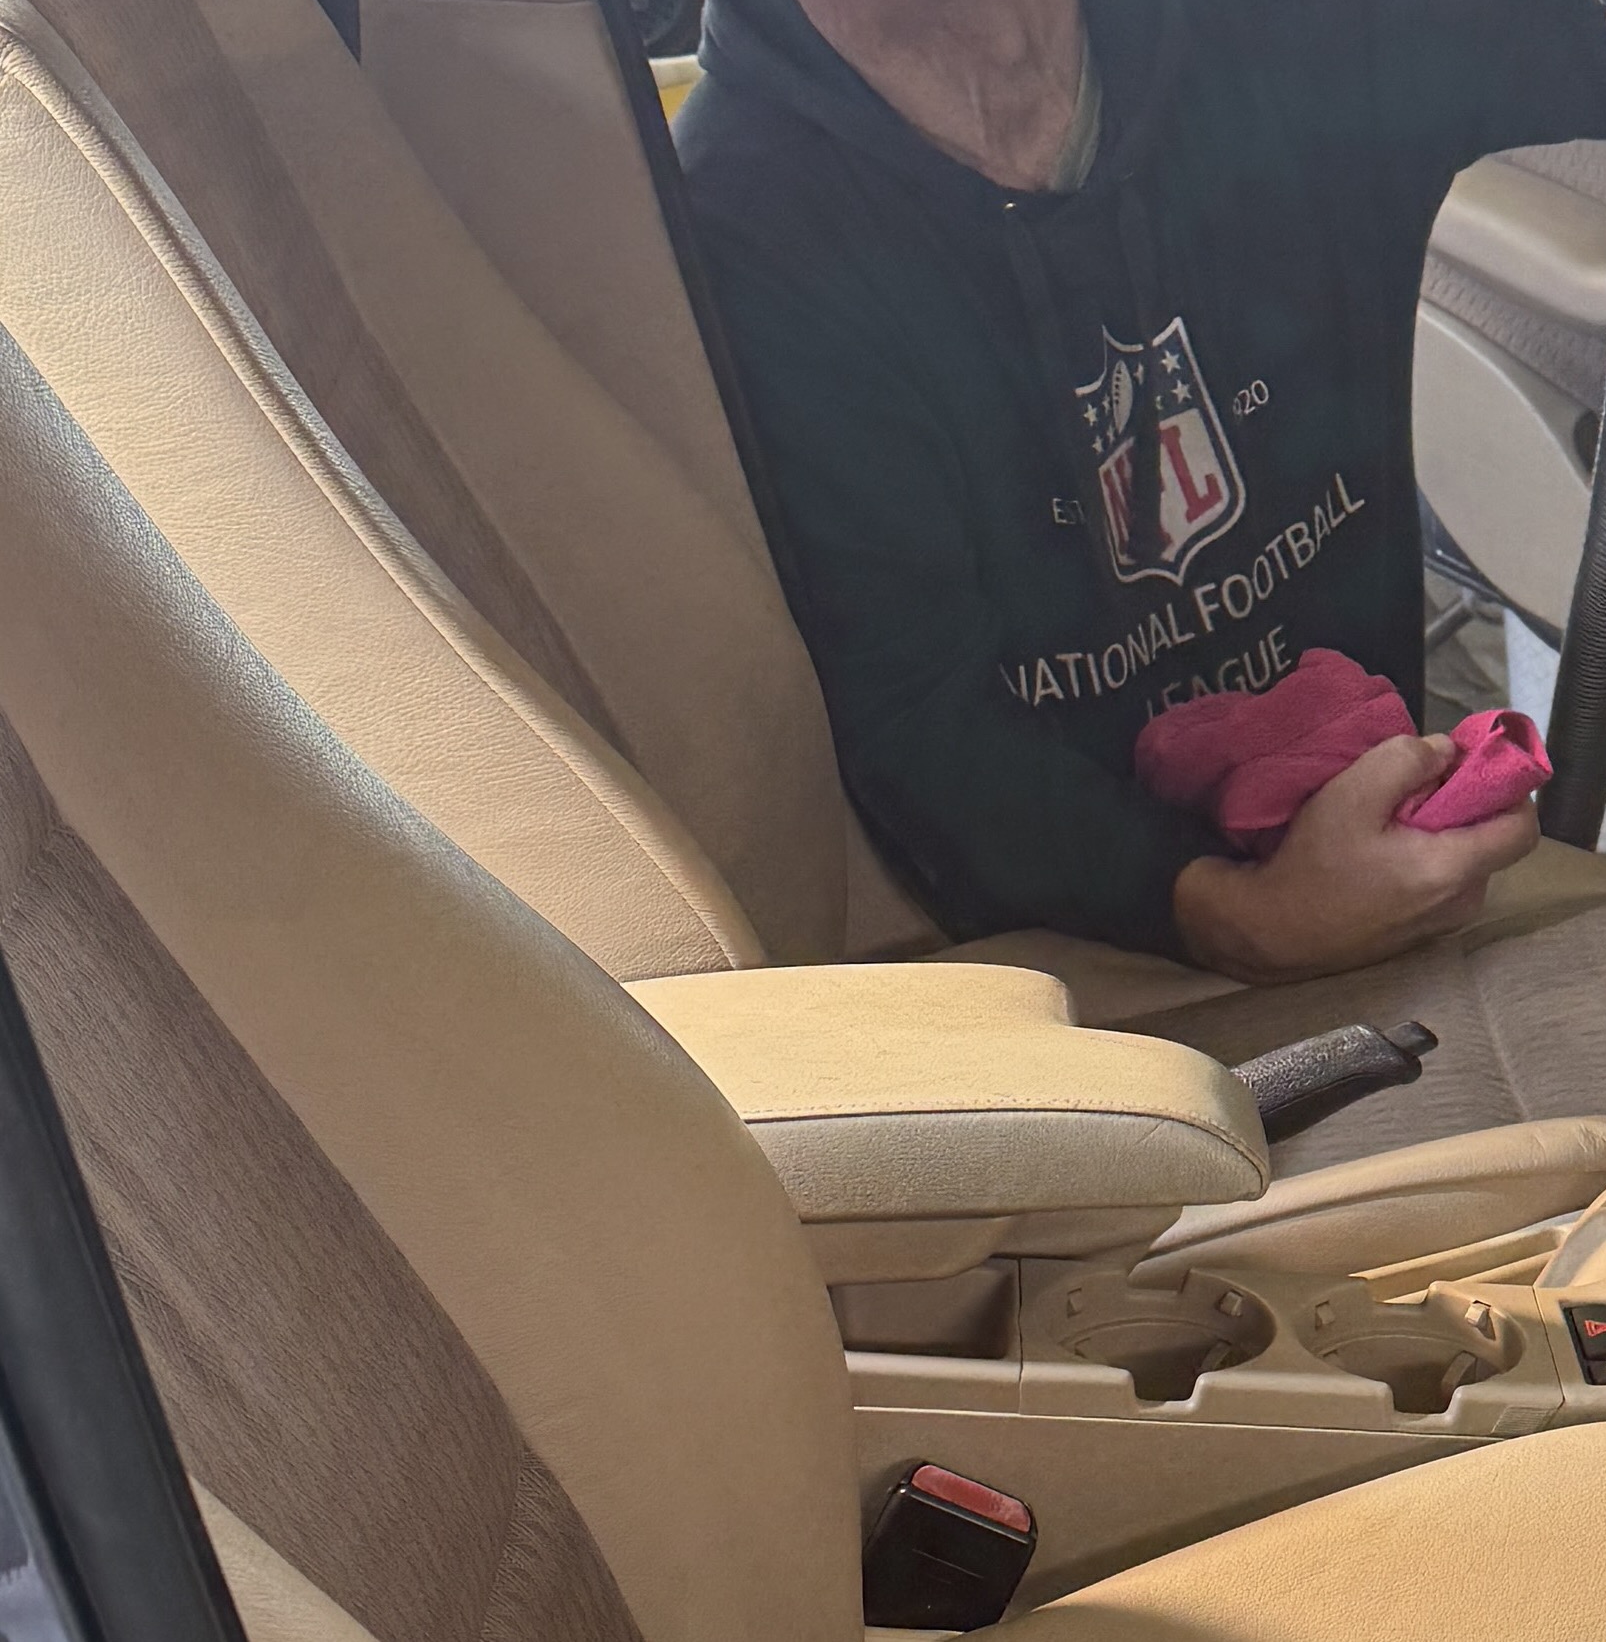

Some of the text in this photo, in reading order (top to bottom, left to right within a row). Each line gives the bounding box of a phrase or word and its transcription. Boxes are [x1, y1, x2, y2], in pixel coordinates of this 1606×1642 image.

[1101, 424, 1223, 558] NL
[1000, 472, 1366, 707] NATIONAL FOOTBALL
